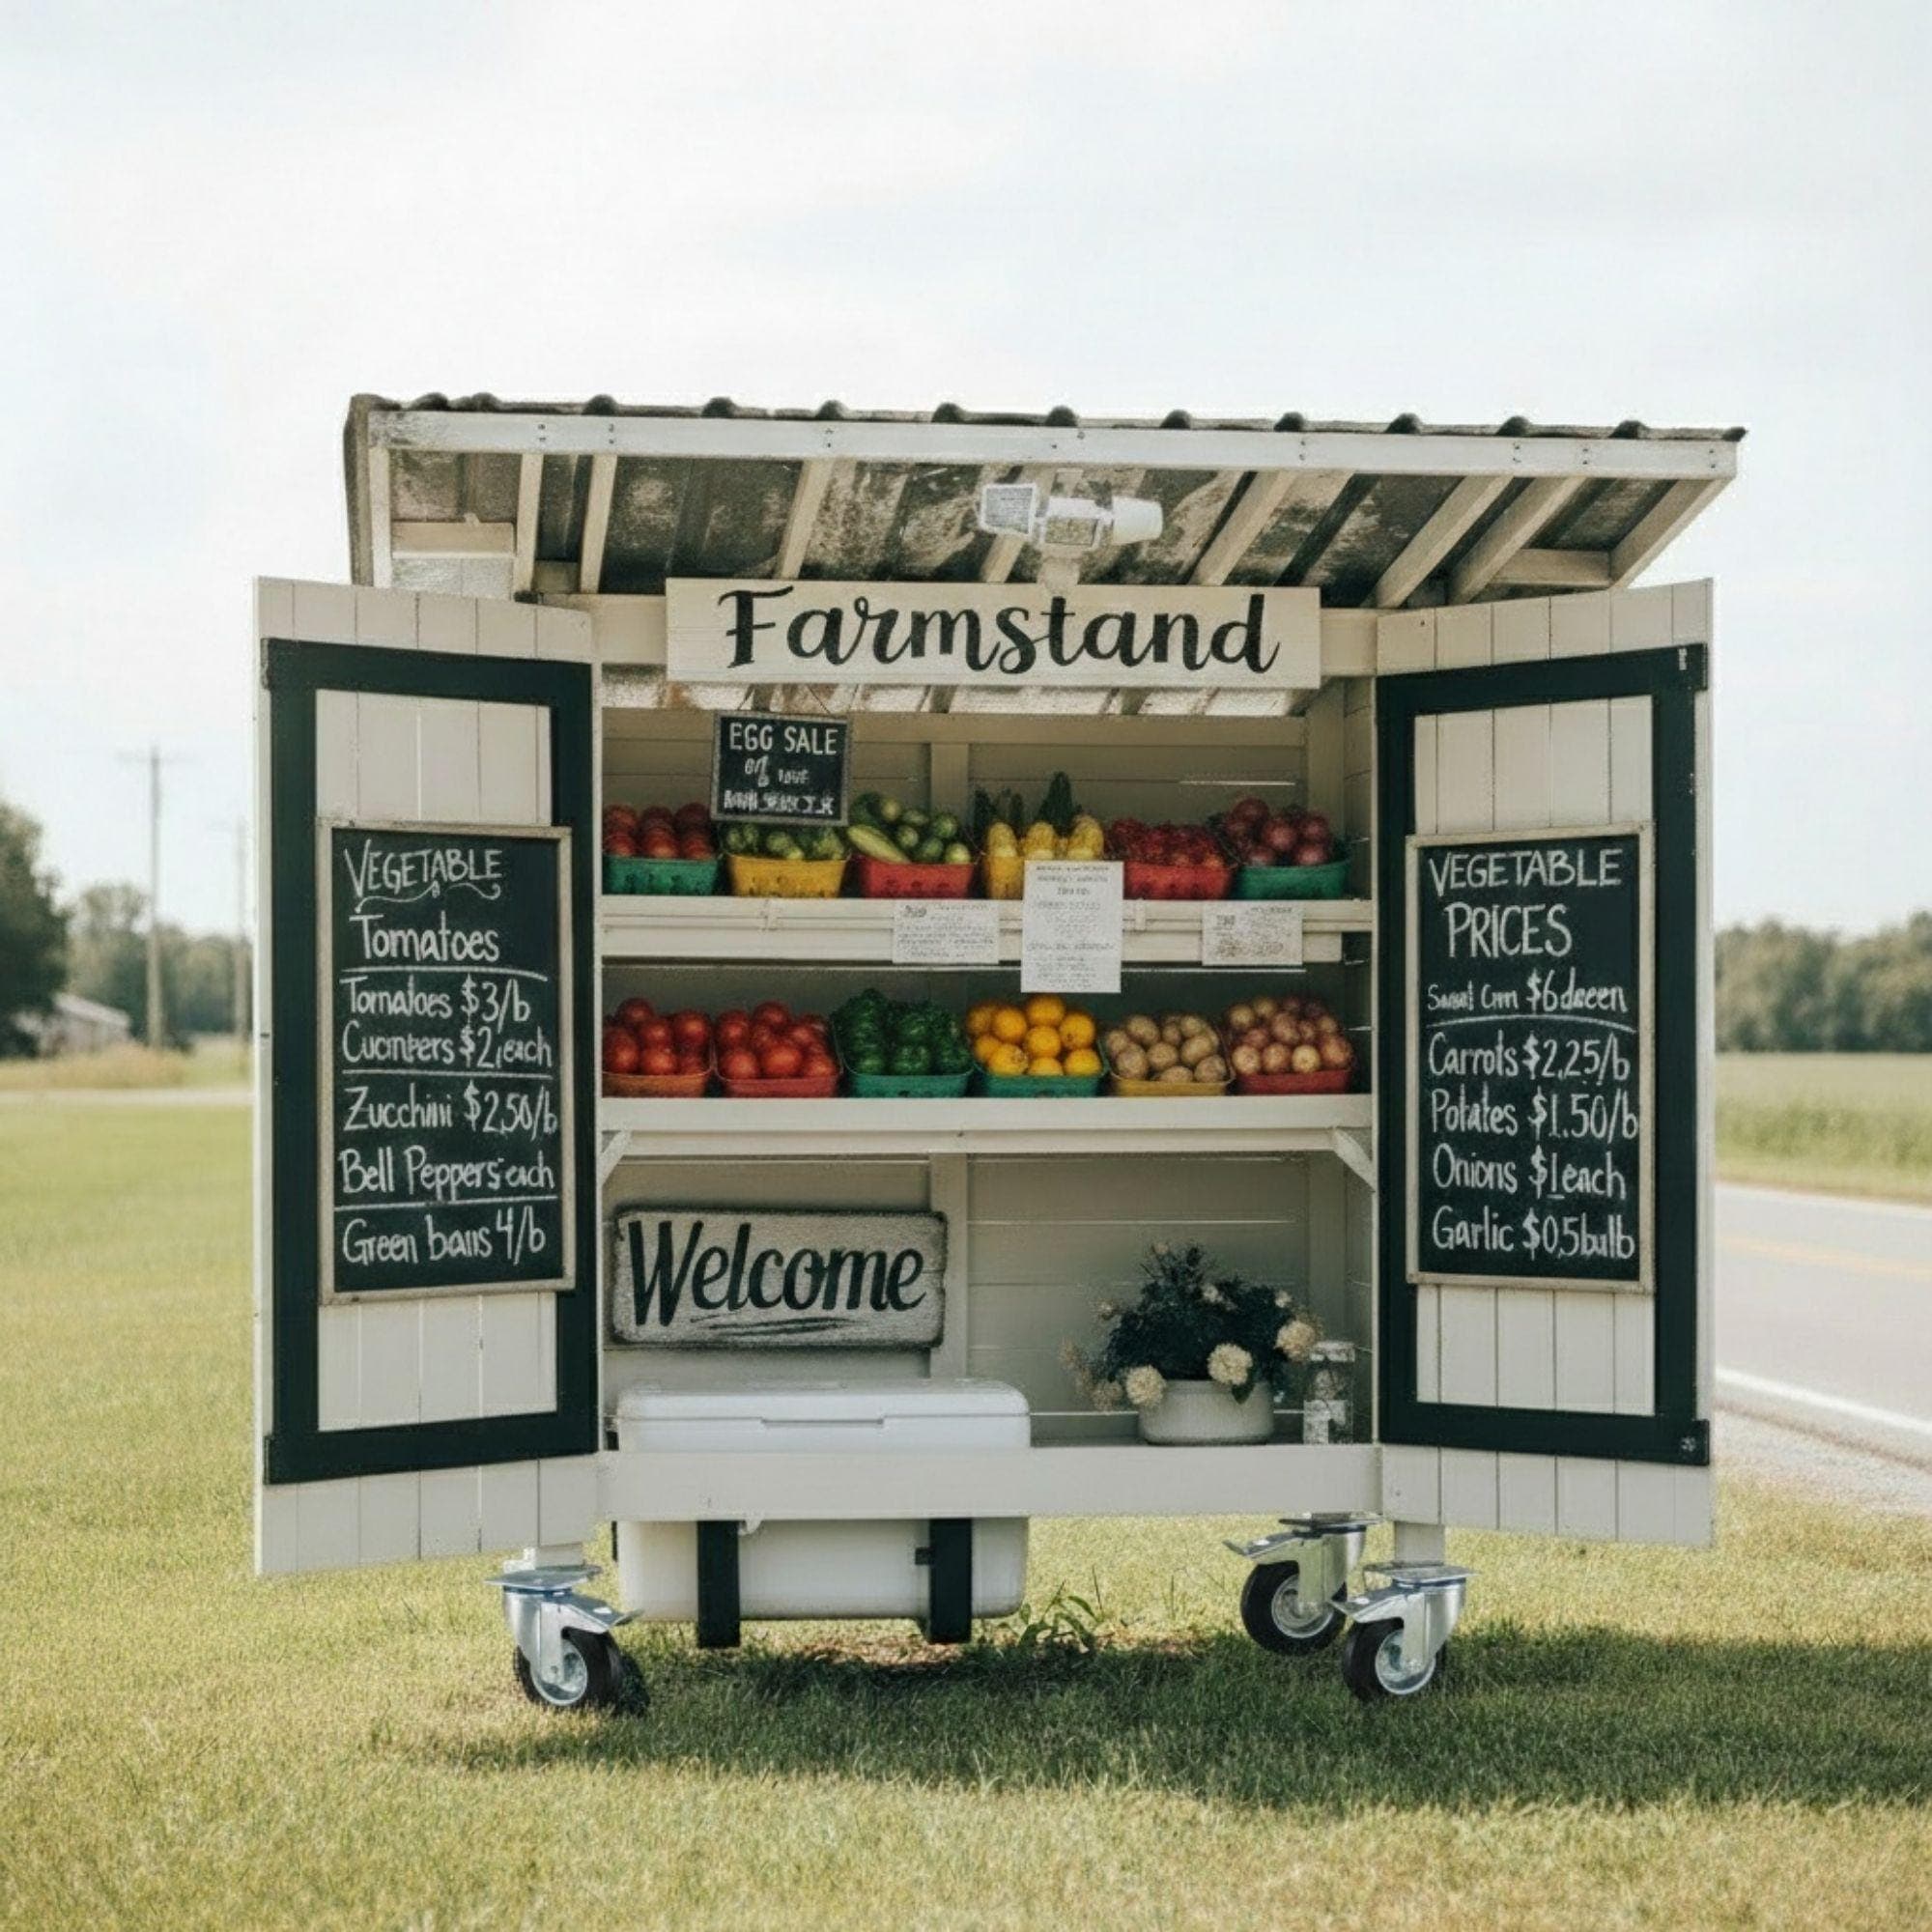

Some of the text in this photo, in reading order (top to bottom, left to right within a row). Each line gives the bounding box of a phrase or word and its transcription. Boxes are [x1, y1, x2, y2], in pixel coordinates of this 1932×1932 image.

[718, 584, 1280, 674] Farmstand
[728, 722, 838, 756] EGG SALE
[344, 838, 503, 897] VEGETABLE
[1428, 848, 1623, 897] VEGETABLE
[349, 910, 500, 962] Tomatoes
[1443, 902, 1574, 958] PRICES
[1428, 1029, 1520, 1077] Carrots
[338, 1146, 395, 1194] Bell
[1433, 1142, 1520, 1195] Onions
[342, 1218, 419, 1265] Green
[1432, 1205, 1515, 1253] Garlic
[627, 1219, 927, 1327] Welcome
